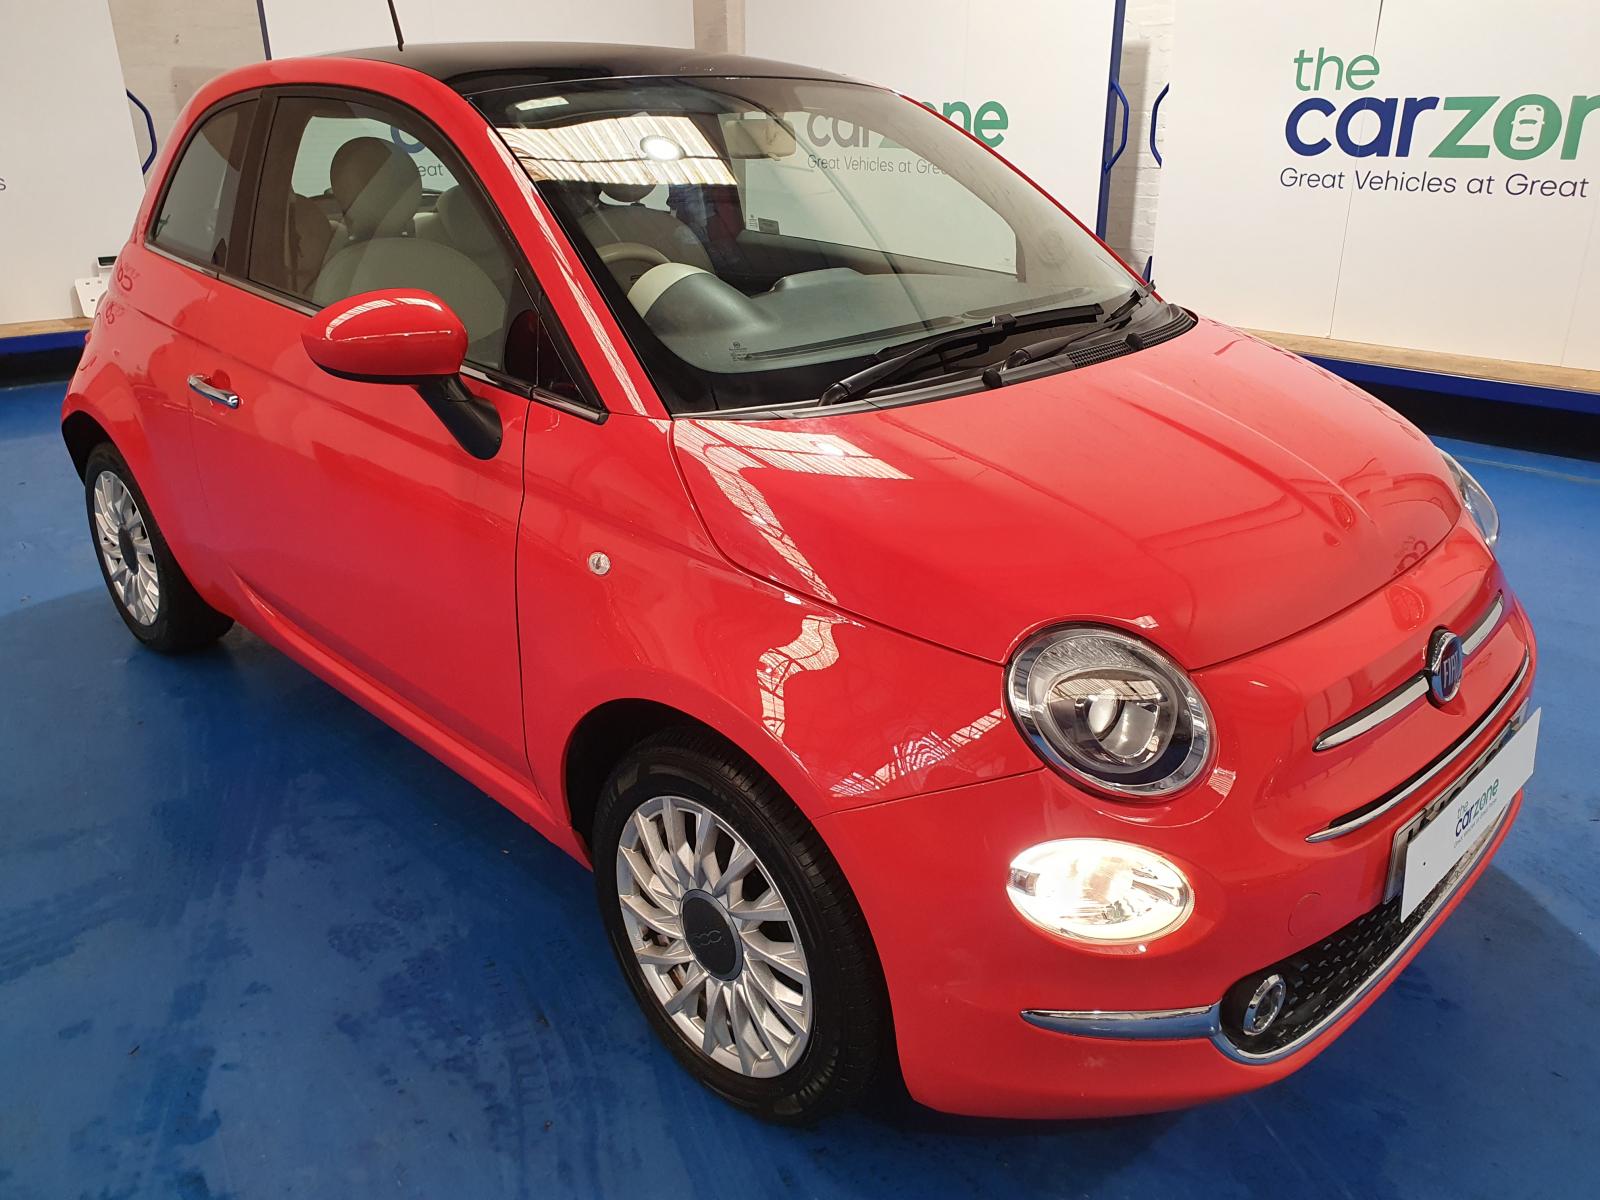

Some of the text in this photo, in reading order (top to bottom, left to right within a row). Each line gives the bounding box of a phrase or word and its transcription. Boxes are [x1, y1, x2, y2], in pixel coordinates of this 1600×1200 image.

[1294, 47, 1380, 91] the
[807, 154, 840, 170] Great
[844, 155, 894, 173] Vehicles
[898, 159, 912, 174] at
[1280, 167, 1590, 198] Great Vehicles at Great
[1455, 778, 1499, 837] carzone
